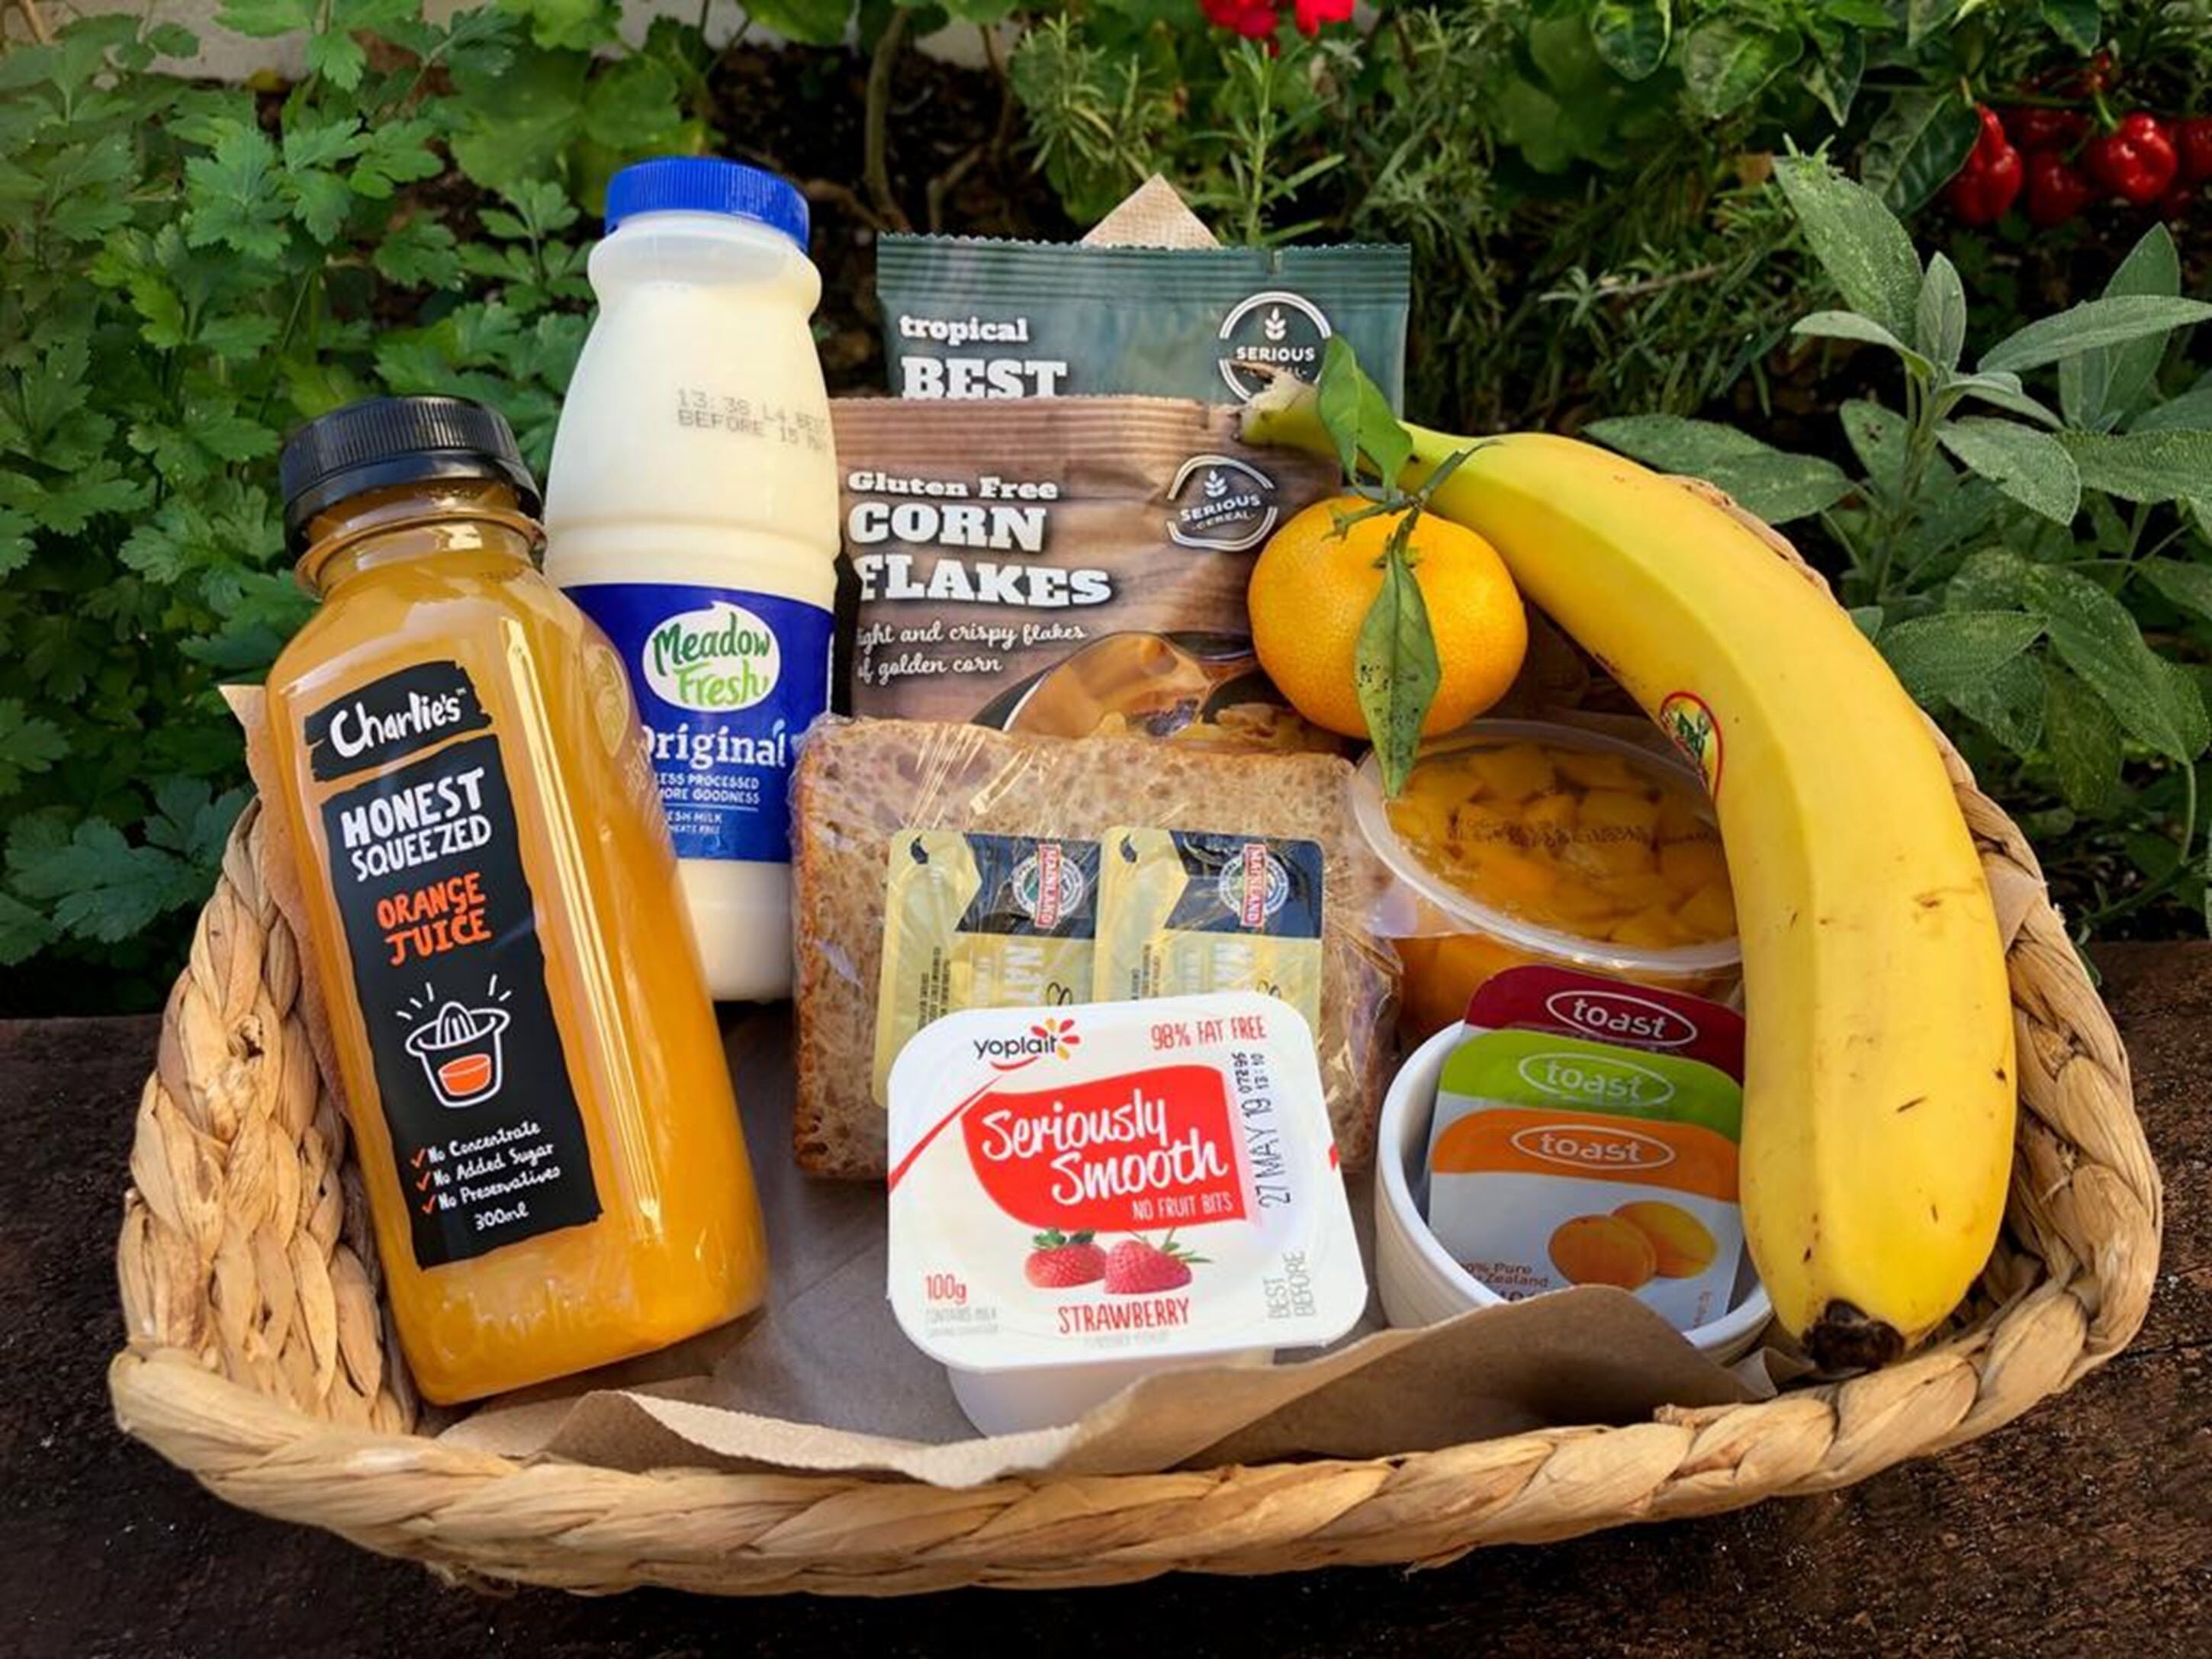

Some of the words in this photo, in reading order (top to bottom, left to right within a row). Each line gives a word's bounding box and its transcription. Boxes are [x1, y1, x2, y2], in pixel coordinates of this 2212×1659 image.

[899, 316, 1028, 346] tropical
[1236, 346, 1315, 362] SERIOUS
[901, 357, 1066, 398] BEST
[678, 410, 765, 436] BEFORE
[847, 471, 969, 497] Gluten
[978, 477, 1058, 499] Free
[848, 502, 1046, 552] CORN
[1180, 494, 1261, 522] SERIOUS
[854, 554, 1111, 607] FLAKES
[653, 612, 770, 677] Meadow
[857, 622, 894, 654] ight
[900, 620, 944, 643] and
[949, 623, 1018, 650] crispy
[1023, 622, 1088, 645] flakes
[673, 659, 770, 706] Fresh
[878, 652, 947, 685] golden
[953, 658, 1002, 673] corn
[330, 691, 461, 757] Charlie's
[661, 772, 685, 786] ESS
[688, 773, 760, 789] PROCESSED
[693, 789, 760, 804] GOODNESS
[340, 767, 484, 848] HONEST
[351, 815, 491, 883] SQUEEZED
[377, 871, 486, 929] ORANGE
[1247, 849, 1265, 922] MAINLAND
[384, 909, 492, 966] JUICE
[1150, 1023, 1191, 1050] 98%
[1196, 1018, 1223, 1045] FAT
[1230, 1015, 1267, 1040] FREE
[1572, 998, 1667, 1040] toast
[973, 1034, 1058, 1059] yoplait
[1545, 1059, 1642, 1100] toast
[982, 1089, 1168, 1162] Seriously
[1241, 1098, 1273, 1118] 19
[427, 1146, 445, 1163] No
[449, 1120, 541, 1157] Concentrate
[1244, 1125, 1286, 1179] MAY
[1539, 1133, 1641, 1163] toast
[433, 1169, 451, 1187] No
[457, 1152, 506, 1182] Added
[509, 1144, 555, 1166] Sugar
[1050, 1129, 1228, 1205] Smooth
[438, 1191, 457, 1210] No
[460, 1165, 561, 1204] Preservatives
[1133, 1203, 1153, 1221] NO
[1158, 1198, 1197, 1219] FRUIT
[1201, 1195, 1233, 1215] BITS
[1255, 1185, 1290, 1208] 27
[474, 1201, 529, 1230] 300ml
[926, 1274, 966, 1305] 100g
[1264, 1276, 1291, 1319] BEST
[1284, 1251, 1316, 1317] BEFORE
[1058, 1297, 1190, 1334] STRAWBERRY
